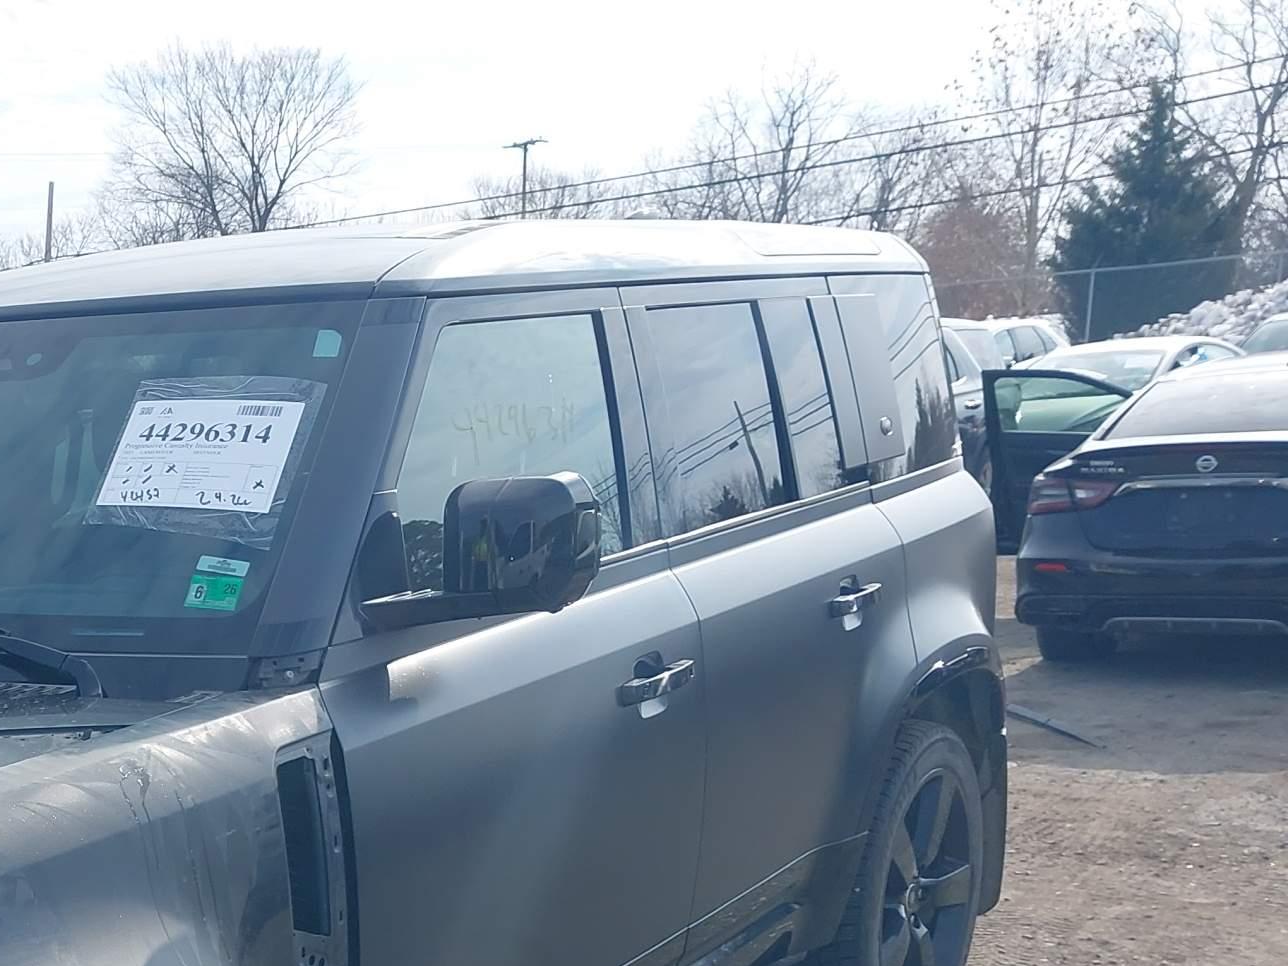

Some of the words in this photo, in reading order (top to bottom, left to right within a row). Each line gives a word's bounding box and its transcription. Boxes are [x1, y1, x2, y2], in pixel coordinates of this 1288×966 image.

[139, 422, 273, 444] 44296314
[194, 585, 204, 600] 6
[223, 583, 237, 595] 26
